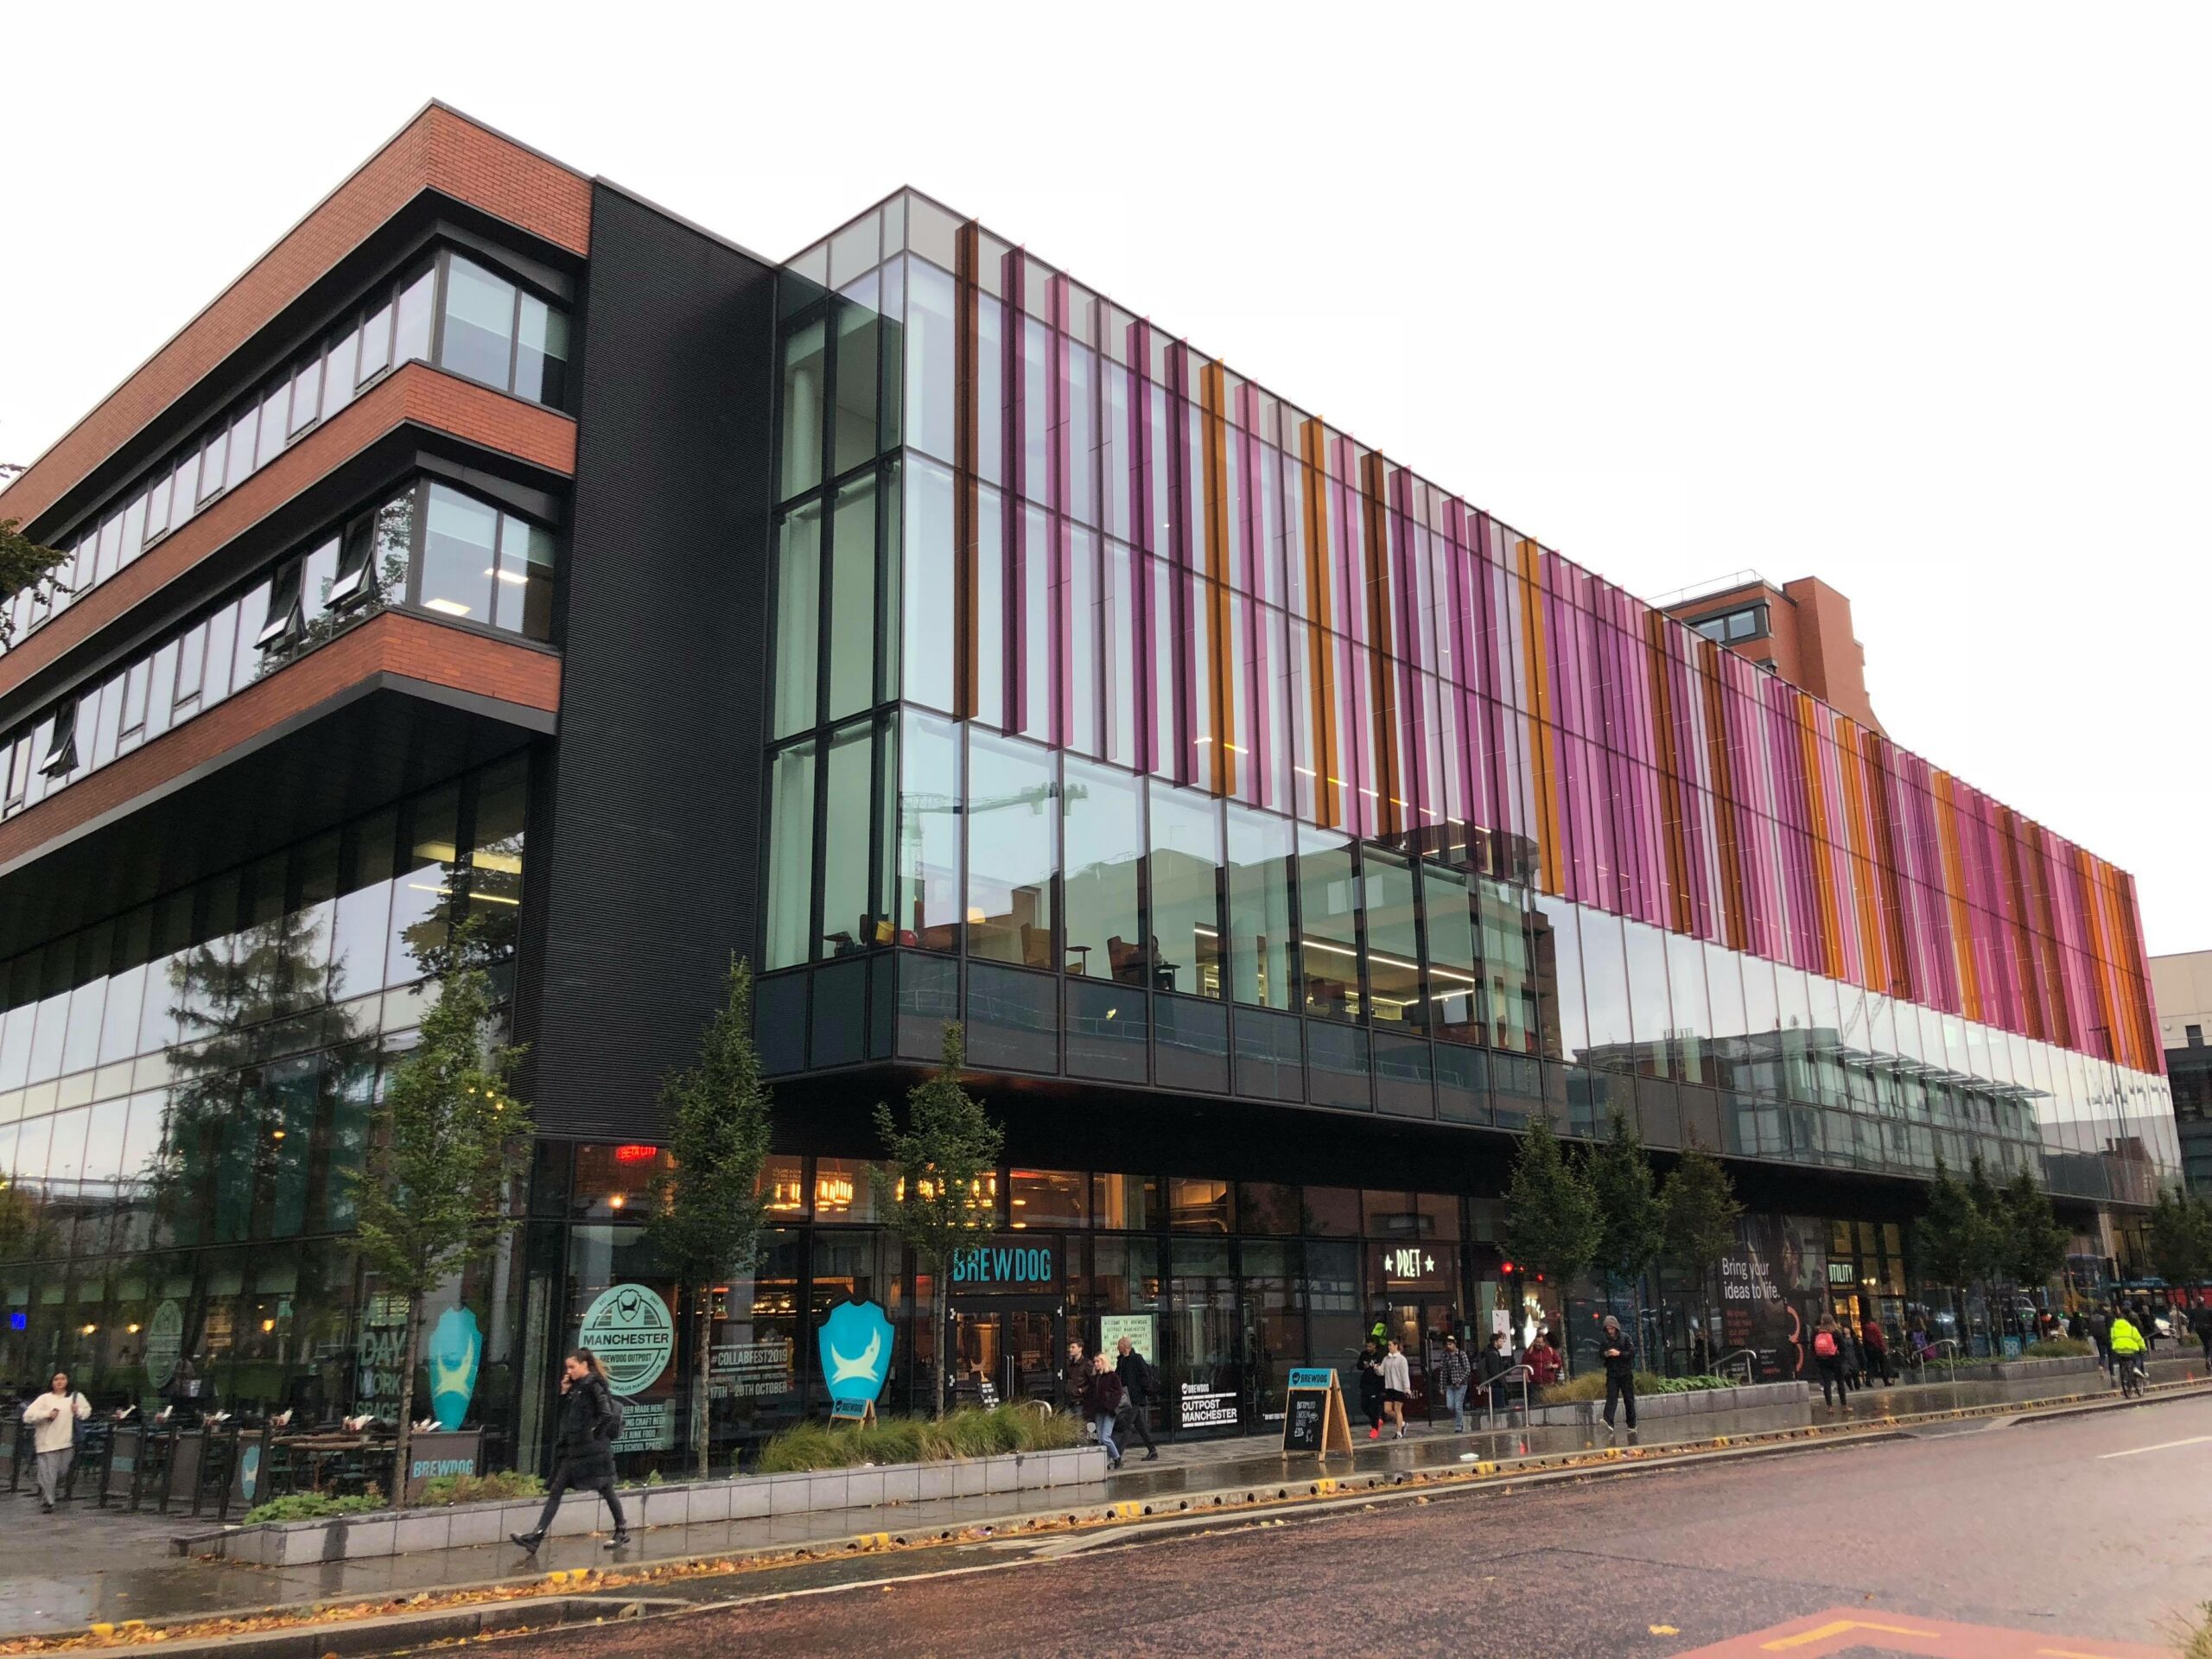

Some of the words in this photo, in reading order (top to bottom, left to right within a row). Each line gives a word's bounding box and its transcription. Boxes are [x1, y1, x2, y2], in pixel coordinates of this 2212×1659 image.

[953, 1247, 1052, 1281] BREWDOG
[1396, 1249, 1421, 1277] PRET
[1722, 1257, 1747, 1280] Bring
[1749, 1262, 1770, 1280] your
[1827, 1264, 1853, 1283] UTILITY
[1724, 1281, 1750, 1299] ideas
[1751, 1282, 1762, 1299] to
[1764, 1281, 1781, 1299] life.
[583, 1333, 669, 1345] MANCHESTER
[359, 1331, 408, 1367] DAY
[628, 1353, 652, 1362] OUTPOST
[710, 1348, 788, 1366] #COLLABFEST2019
[1300, 1373, 1327, 1383] BREWDOG
[710, 1386, 728, 1399] 17TH
[734, 1382, 754, 1397] 20TH
[755, 1382, 788, 1395] OCTOBER
[1187, 1383, 1209, 1393] BREWDOG
[622, 1405, 634, 1414] EER
[634, 1404, 650, 1414] MADE
[650, 1403, 664, 1413] HERE
[1182, 1399, 1221, 1411] OUTPOST
[635, 1417, 652, 1426] CRAFT
[653, 1416, 666, 1425] BEER
[1182, 1408, 1236, 1422] MANCHESTER
[611, 1444, 623, 1452] EER
[624, 1442, 645, 1452] SCHOOL
[413, 1459, 474, 1478] BREWDOG
